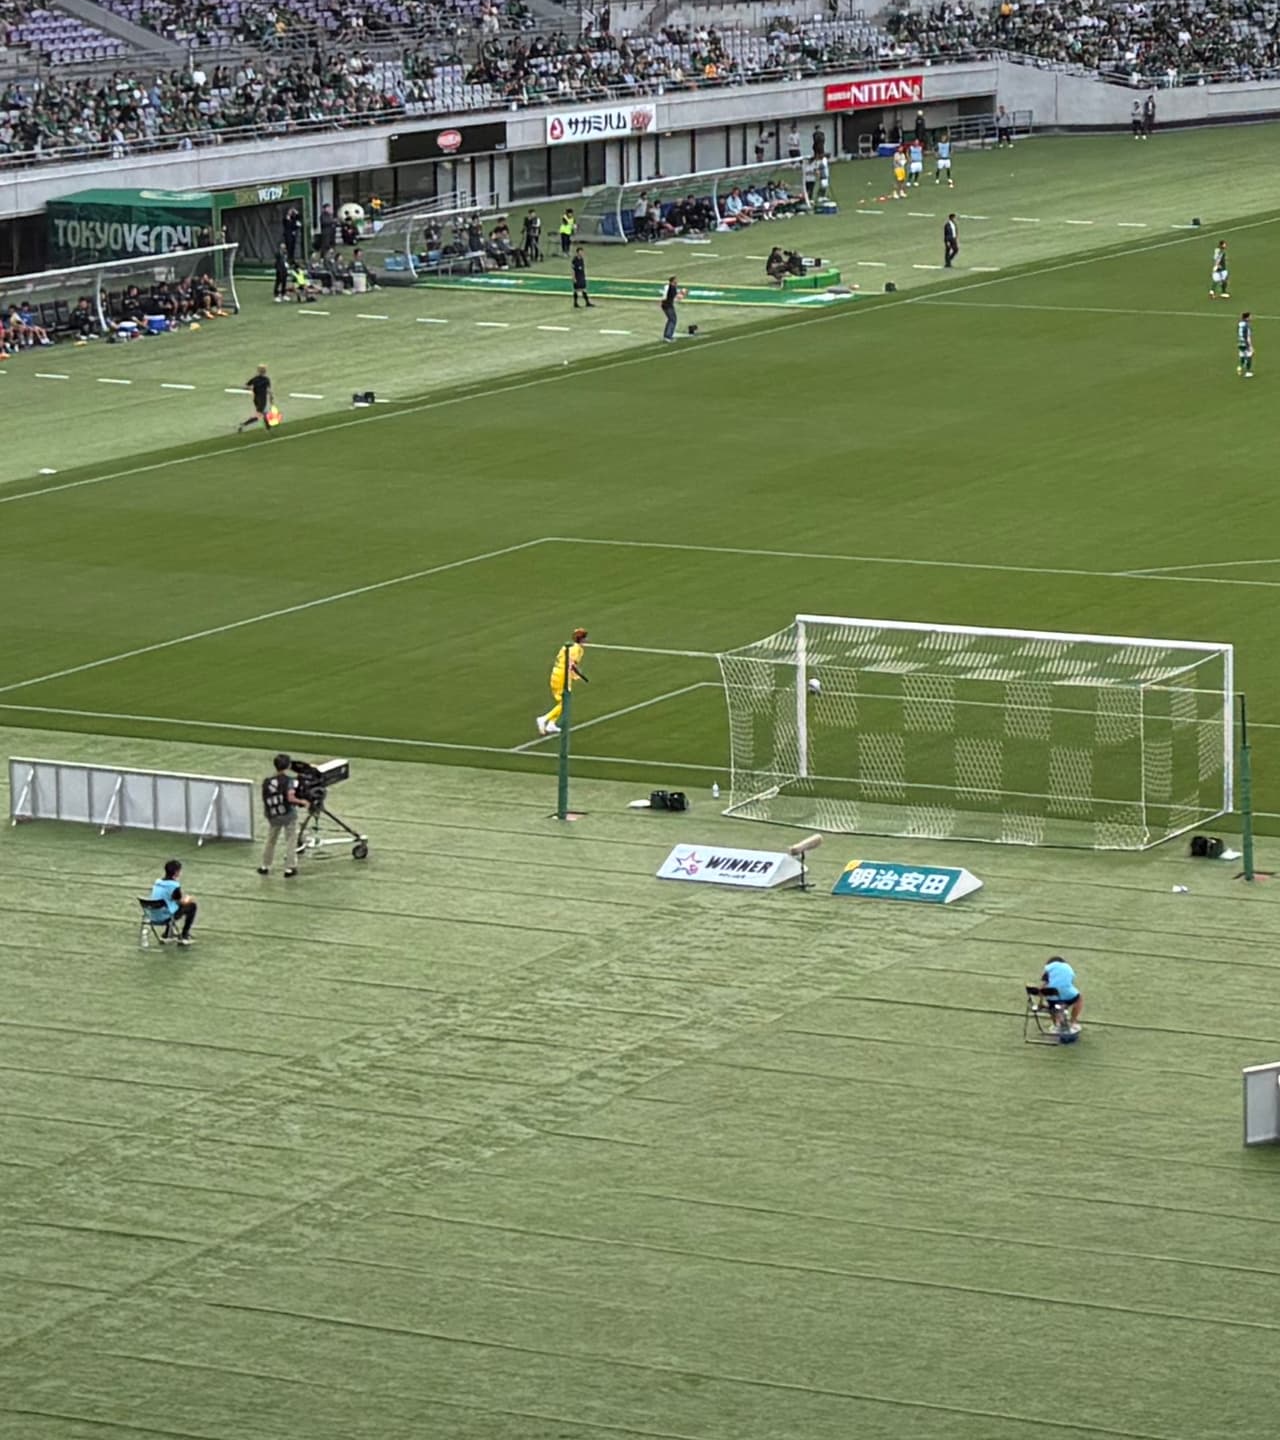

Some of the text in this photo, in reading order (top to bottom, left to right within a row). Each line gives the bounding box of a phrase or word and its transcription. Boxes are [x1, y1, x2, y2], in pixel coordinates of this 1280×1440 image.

[850, 78, 914, 105] NITTAN
[567, 111, 628, 135] サガミハム
[705, 855, 774, 875] WINNER
[848, 868, 950, 895] 明治安田
